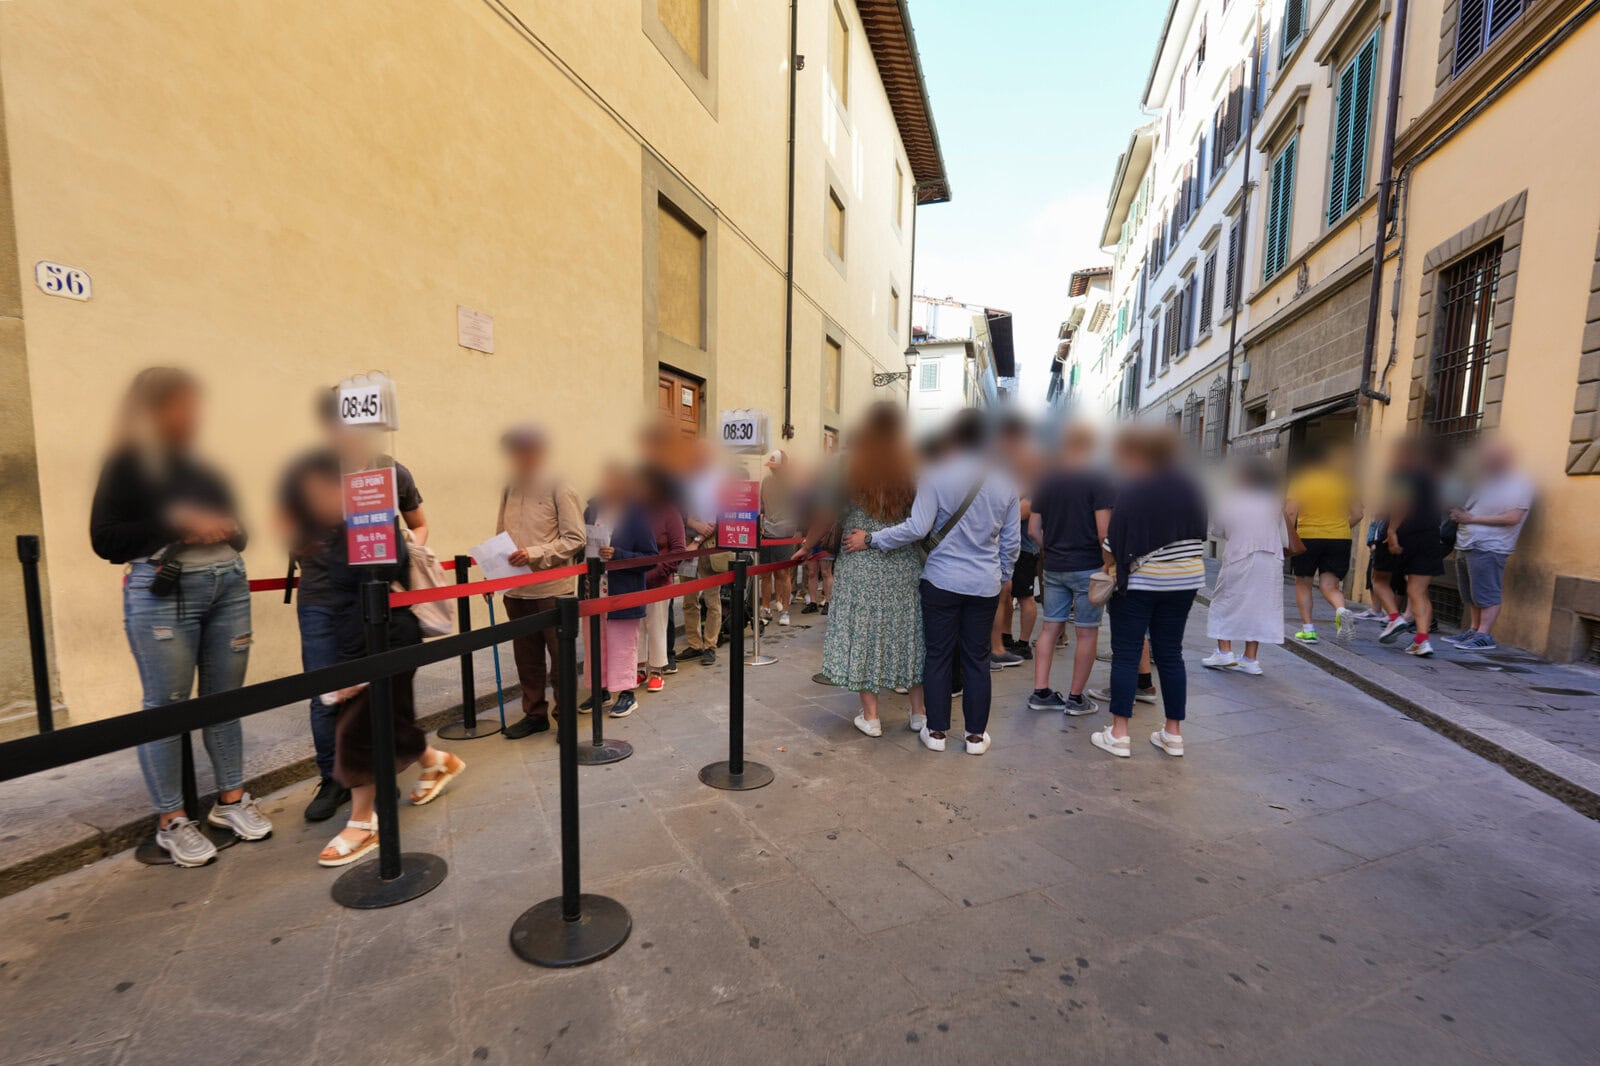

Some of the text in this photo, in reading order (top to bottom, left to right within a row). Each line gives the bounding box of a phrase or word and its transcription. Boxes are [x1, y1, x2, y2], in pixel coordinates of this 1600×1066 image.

[46, 266, 83, 295] 56
[342, 394, 378, 418] 08:45
[723, 423, 753, 440] 08:30
[370, 512, 387, 523] HERE
